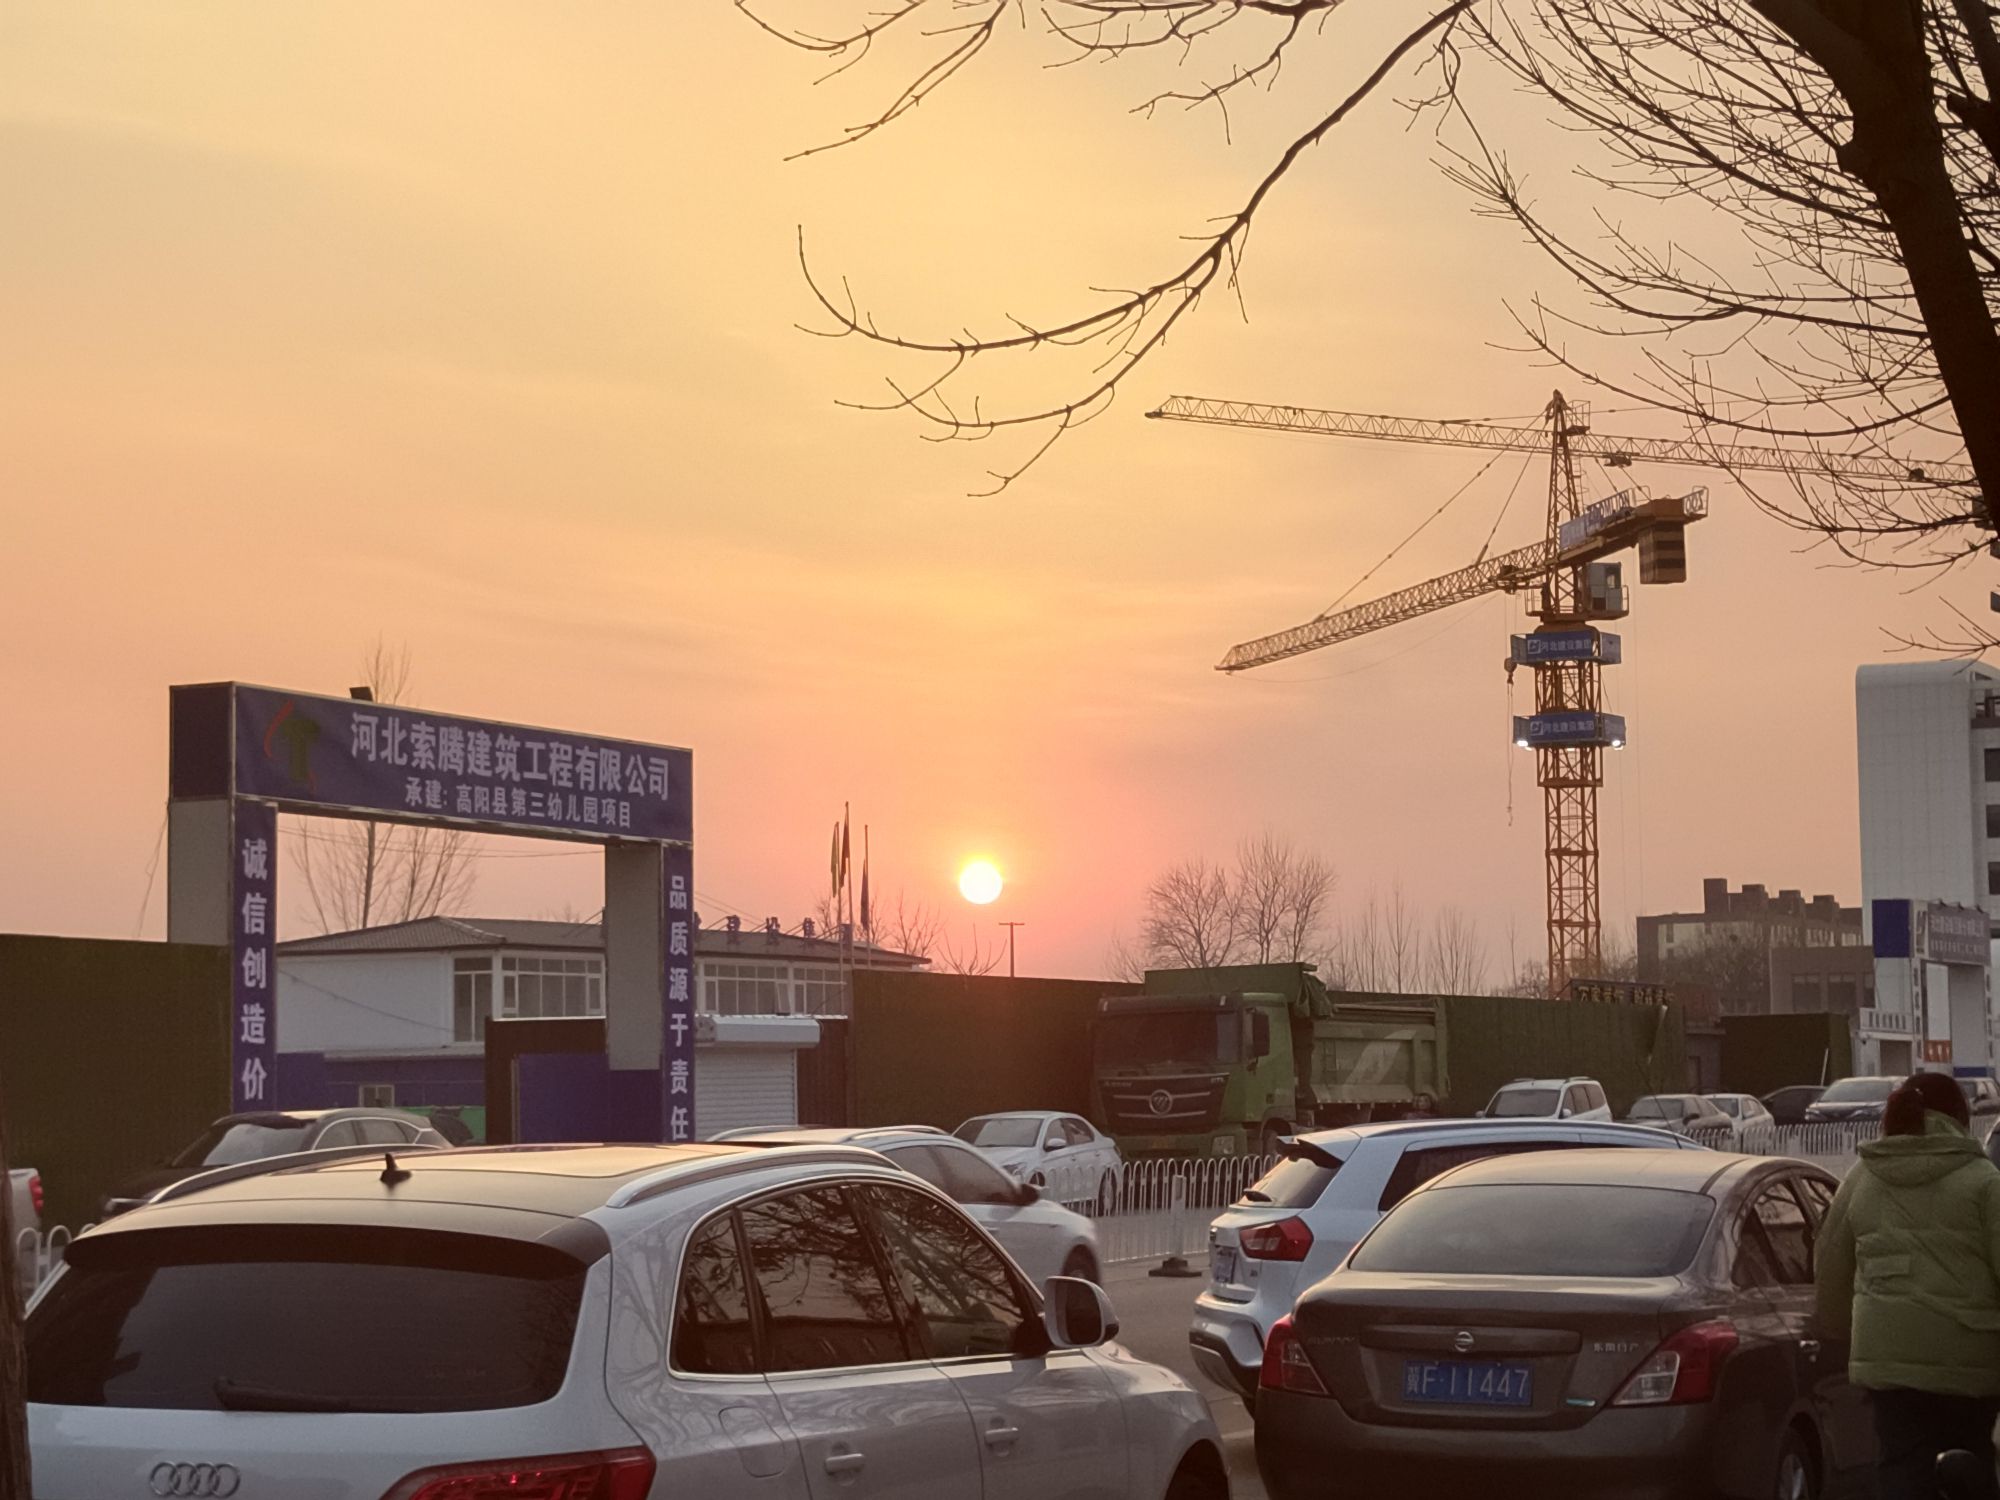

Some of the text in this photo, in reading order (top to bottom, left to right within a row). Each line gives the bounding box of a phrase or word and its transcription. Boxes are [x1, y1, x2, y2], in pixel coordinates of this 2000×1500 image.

[351, 711, 669, 801] 河北索腾建筑工程有限公司
[241, 838, 268, 1100] 诚信创造价
[669, 875, 689, 1141] 品质源于责任
